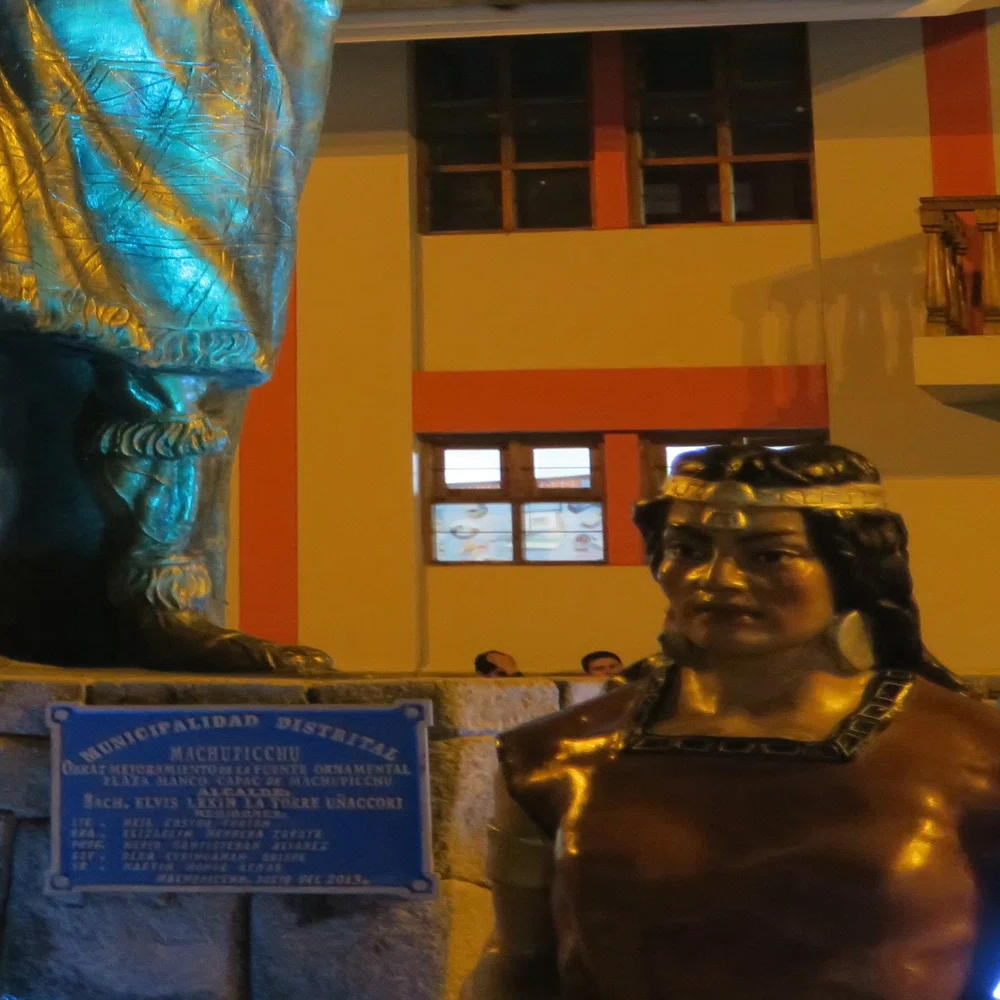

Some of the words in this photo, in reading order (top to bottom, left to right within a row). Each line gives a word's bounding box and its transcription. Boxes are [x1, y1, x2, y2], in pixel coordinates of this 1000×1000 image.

[79, 714, 260, 763] MUNICIPALIDAD
[275, 716, 400, 761] DISTRITAL
[169, 745, 301, 762] MACHUPICCHU
